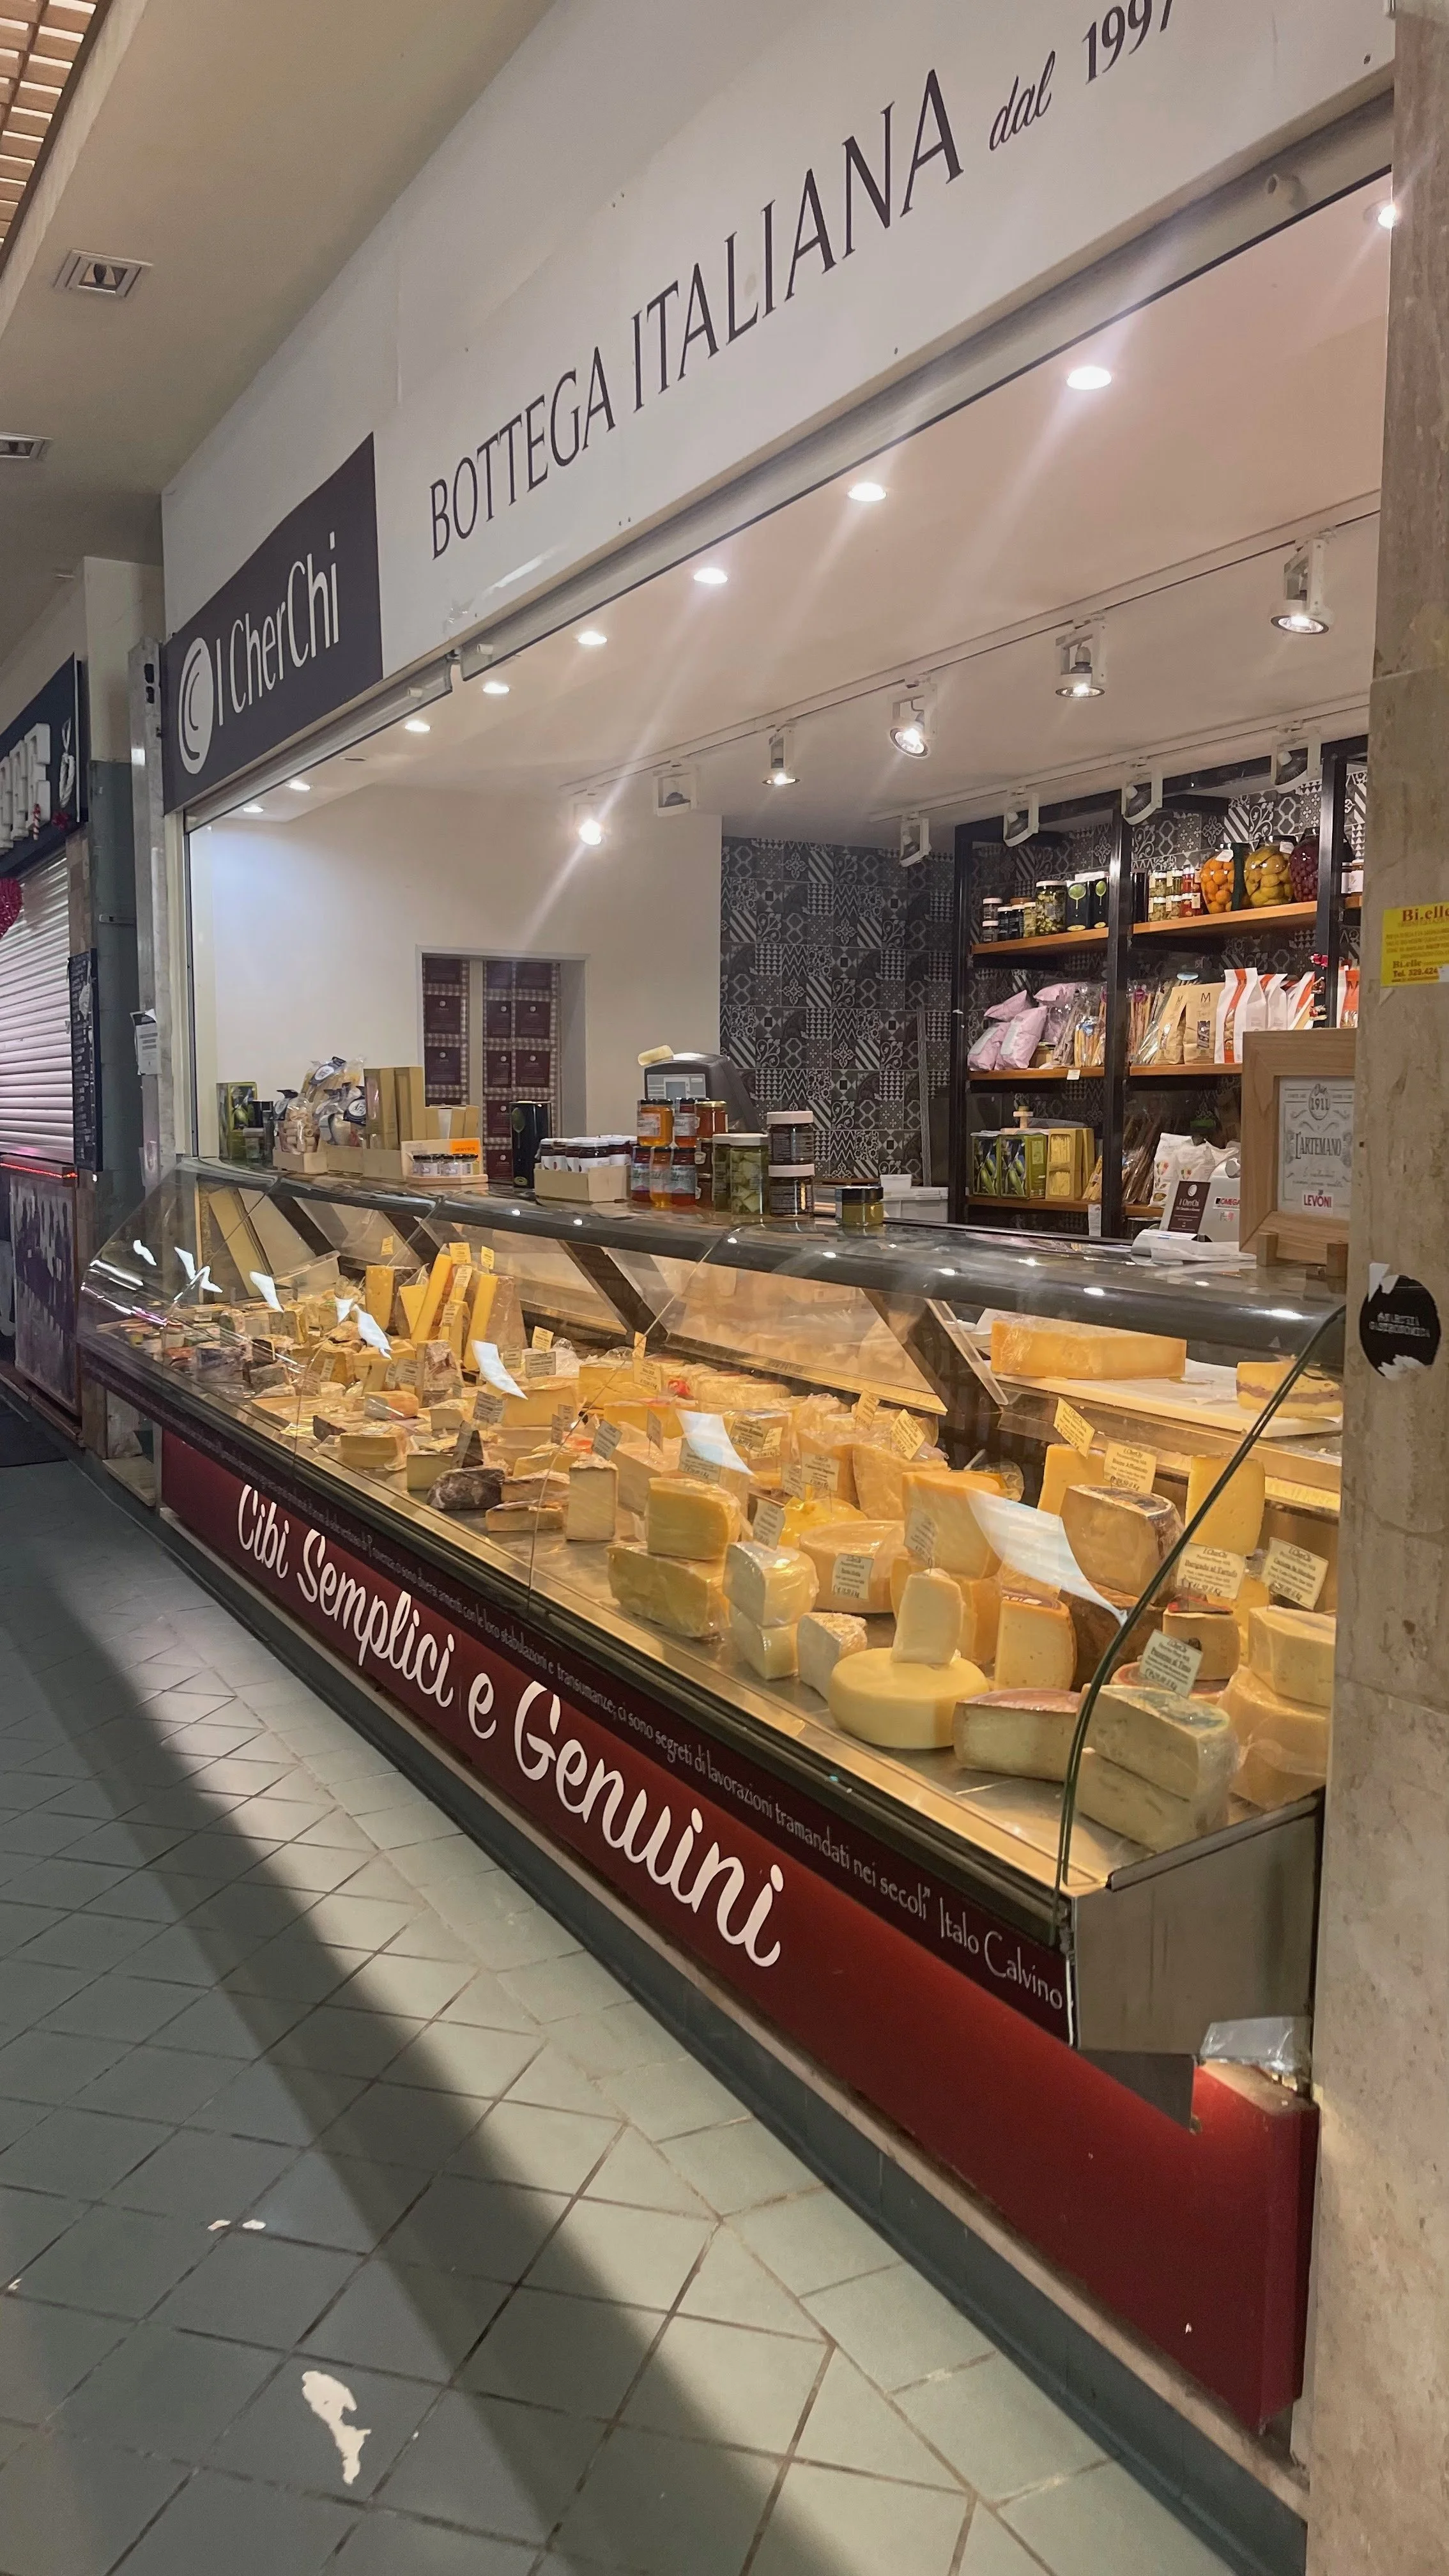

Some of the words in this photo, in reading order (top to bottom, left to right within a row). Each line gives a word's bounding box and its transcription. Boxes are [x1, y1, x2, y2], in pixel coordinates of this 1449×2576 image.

[429, 346, 616, 560] BOTTEGA
[632, 68, 964, 413] ITALIANA
[988, 50, 1055, 151] dal
[215, 638, 224, 726] I
[230, 531, 339, 714] CherChi
[1303, 1194, 1333, 1208] LEVONI
[1310, 1099, 1330, 1111] 1911
[238, 1484, 289, 1579] Cibi
[296, 1528, 454, 1708] Semplici
[467, 1672, 497, 1740] e
[514, 1680, 784, 1968] Genuini
[628, 1712, 653, 1739] sono
[655, 1729, 692, 1767] segreti
[694, 1744, 705, 1776] di
[707, 1749, 772, 1819] lavorazioni
[775, 1802, 850, 1869] tramandati
[854, 1861, 876, 1887] nei
[939, 1896, 979, 1955] Italo
[984, 1930, 1063, 2010] Calvino
